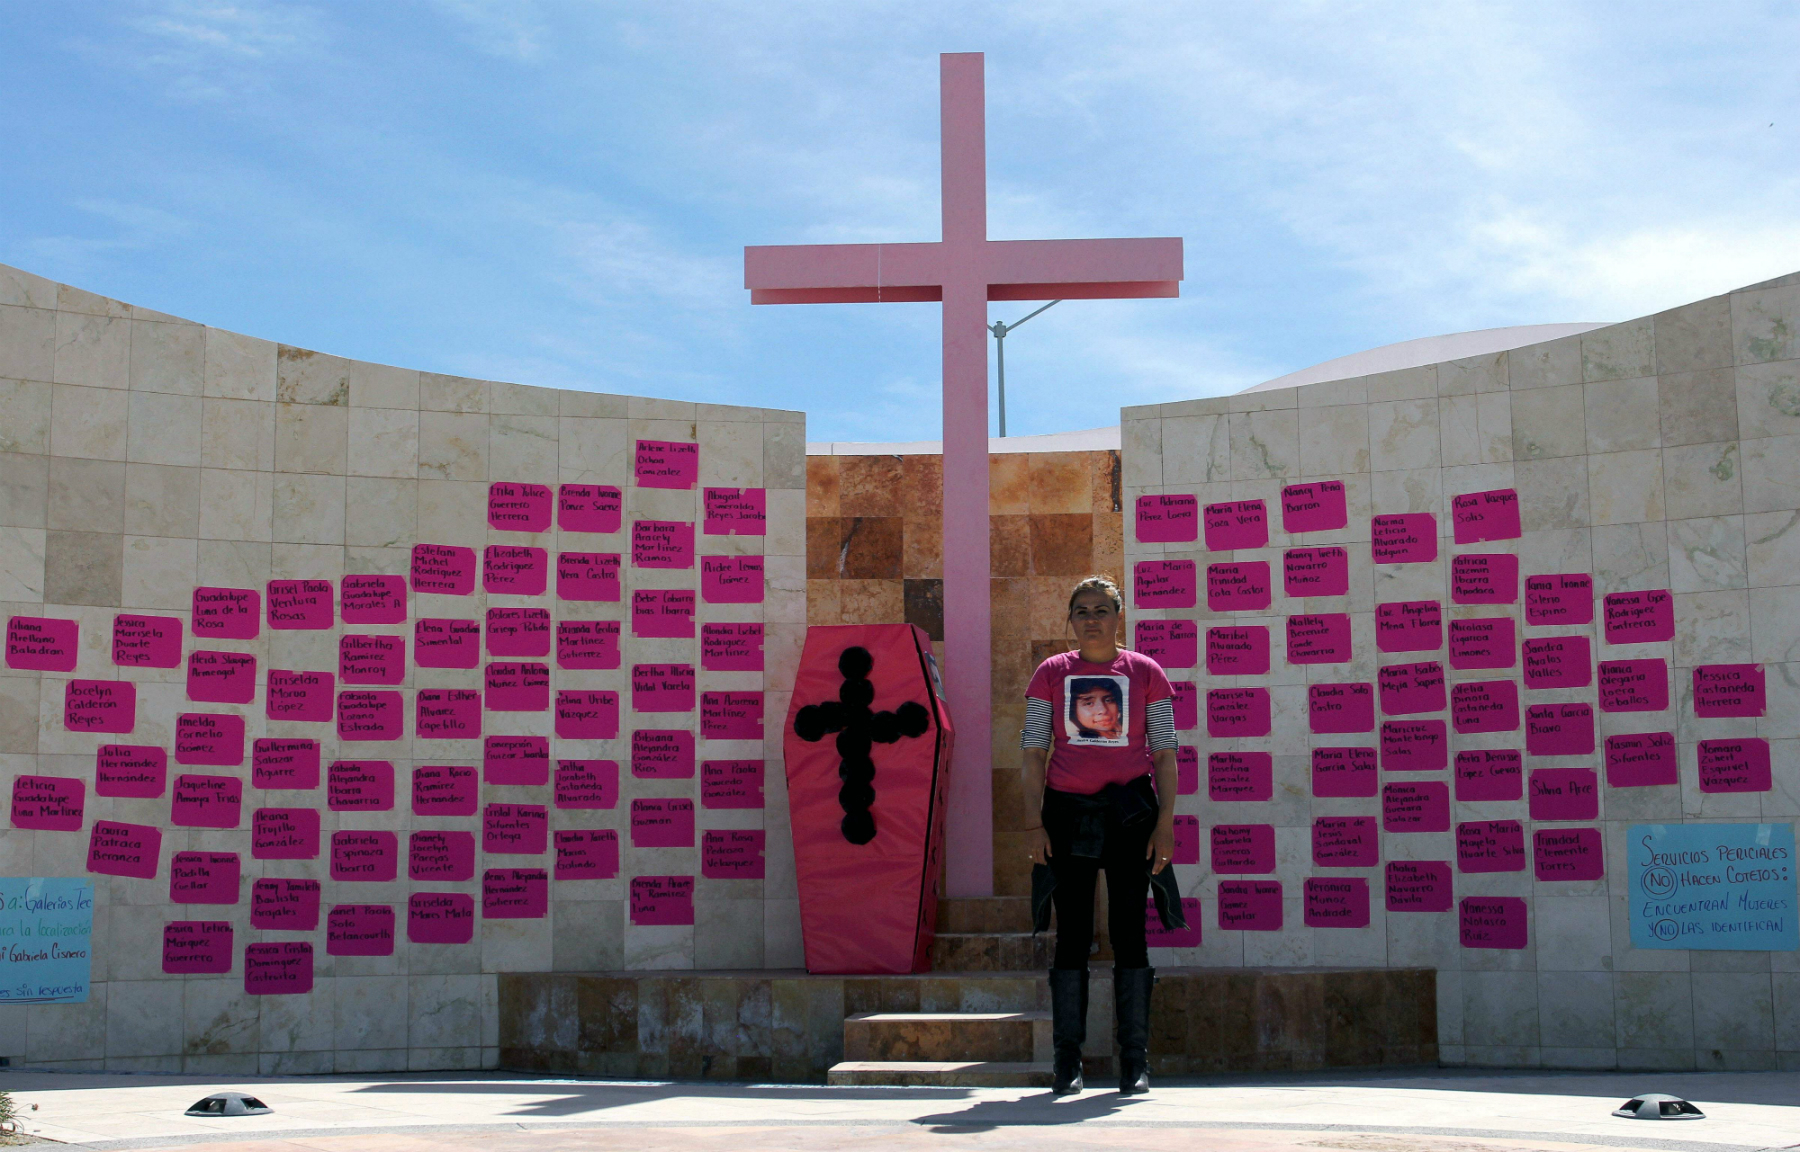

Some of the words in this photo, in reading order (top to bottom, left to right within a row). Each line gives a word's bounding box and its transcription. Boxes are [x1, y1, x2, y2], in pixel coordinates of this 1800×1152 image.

[1284, 488, 1313, 498] Nancy
[490, 499, 529, 508] Guerrero
[1455, 496, 1478, 508] Rosa
[492, 512, 529, 520] Herrera
[708, 510, 733, 520] Reyes
[1236, 516, 1260, 524] Vera
[1374, 518, 1404, 526] Norma
[1374, 535, 1418, 546] Alvarado
[486, 547, 532, 558] Elizabeth
[635, 553, 671, 562] Ramos
[415, 556, 448, 566] Michel
[1287, 562, 1327, 572] Navarro
[559, 570, 579, 579] Vera
[587, 568, 615, 579] Castro
[302, 580, 328, 592] Paola
[343, 578, 385, 588] Gabriela
[415, 578, 454, 588] Herrera
[196, 589, 248, 604] Guadalupe
[343, 590, 391, 600] Guadalupe
[271, 596, 316, 608] Ventura
[344, 601, 385, 610] Morales
[1606, 596, 1640, 606] Vanessa
[196, 605, 217, 615] Luna
[222, 606, 233, 614] de
[238, 605, 248, 613] la
[271, 610, 306, 620] Rosas
[488, 610, 520, 620] Dolores
[1530, 608, 1566, 617] Espino
[10, 619, 42, 632] Liliana
[196, 618, 224, 628] Rosa
[416, 621, 443, 633] Elena
[1289, 618, 1323, 627] Nallely
[1452, 622, 1492, 632] Nicolasa
[1608, 620, 1656, 631] Contreras
[10, 632, 55, 643] Arellano
[115, 629, 162, 638] Marisela
[1210, 630, 1248, 640] Maribel
[1290, 628, 1329, 638] Berenice
[116, 639, 150, 648] Duarte
[1210, 642, 1252, 650] Alvarado
[1525, 641, 1563, 654] Sandra
[117, 650, 150, 663] Reyes
[1291, 649, 1334, 657] Chavarria
[344, 665, 386, 676] Monroy
[1528, 668, 1562, 678] Valles
[1697, 668, 1740, 681] Yessica
[270, 672, 318, 685] Griselda
[1601, 674, 1645, 686] Olegario
[68, 681, 112, 699] Jocelyn
[1311, 687, 1344, 697] Claudia
[1350, 685, 1368, 694] Soto
[1603, 688, 1634, 696] Loera
[704, 694, 718, 705] Ana
[1210, 691, 1254, 700] Marisela
[339, 701, 386, 710] Guadalupe
[1312, 701, 1342, 711] Castro
[1604, 696, 1648, 706] Ceballos
[1698, 697, 1741, 707] Herrera
[340, 712, 374, 720] Lozano
[1528, 708, 1554, 718] Santa
[68, 712, 104, 727] Reyes
[179, 716, 215, 727] Imelda
[1212, 715, 1246, 724] Vargas
[1456, 716, 1480, 725] Luna
[340, 722, 384, 732] Estrada
[634, 732, 673, 742] Bibiana
[255, 740, 312, 752] Guillermina
[634, 743, 679, 753] Alejandra
[100, 747, 130, 756] Julia
[255, 756, 293, 764] Salazar
[1210, 755, 1242, 763] Martha
[1458, 754, 1480, 762] Perla
[705, 764, 722, 775] Ana
[732, 763, 756, 774] Paola
[1702, 762, 1748, 774] Esquivel
[256, 768, 294, 780] Aguirre
[330, 774, 375, 784] Alejandra
[416, 769, 440, 779] Diana
[175, 776, 226, 792] Jaqueline
[330, 786, 361, 794] Ibarra
[14, 793, 69, 806] Guadalupe
[176, 792, 209, 808] Amaya
[558, 793, 601, 802] Alvarado
[1386, 795, 1429, 805] Alejandra
[96, 822, 128, 836] Laura
[1459, 824, 1480, 835] Rosa
[333, 833, 378, 845] Gabriela
[706, 832, 724, 842] Ana
[732, 832, 754, 842] Rosa
[1214, 836, 1251, 845] Gabriela
[1316, 835, 1362, 847] Sandoval
[1460, 837, 1496, 850] Mayela
[335, 848, 383, 860] Espinoza
[1536, 845, 1588, 857] Clemente
[1641, 835, 1709, 866] SERVICIOS
[1716, 845, 1787, 861] PERICIALES
[336, 863, 374, 872] Ibarra
[1540, 862, 1575, 870] Torres
[1388, 873, 1437, 882] Elizabeth
[1650, 873, 1670, 888] NO
[1681, 871, 1721, 887] HACEN
[25, 884, 73, 914] Galerias
[73, 888, 92, 909] Tec
[1643, 892, 1729, 917] ENCUENTRAN
[1738, 890, 1787, 911] MUJERES
[1309, 908, 1352, 916] Andrade
[1462, 900, 1504, 914] Vanessa
[1464, 917, 1506, 926] Nolasco
[1659, 924, 1675, 935] NO
[1682, 921, 1704, 935] LAS
[1712, 917, 1783, 933] IDENTIFICAN
[20, 920, 30, 936] la
[10, 943, 48, 962] Gabriela
[166, 952, 212, 962] Guerrero
[16, 984, 33, 996] sin
[39, 982, 82, 997] respuesta
